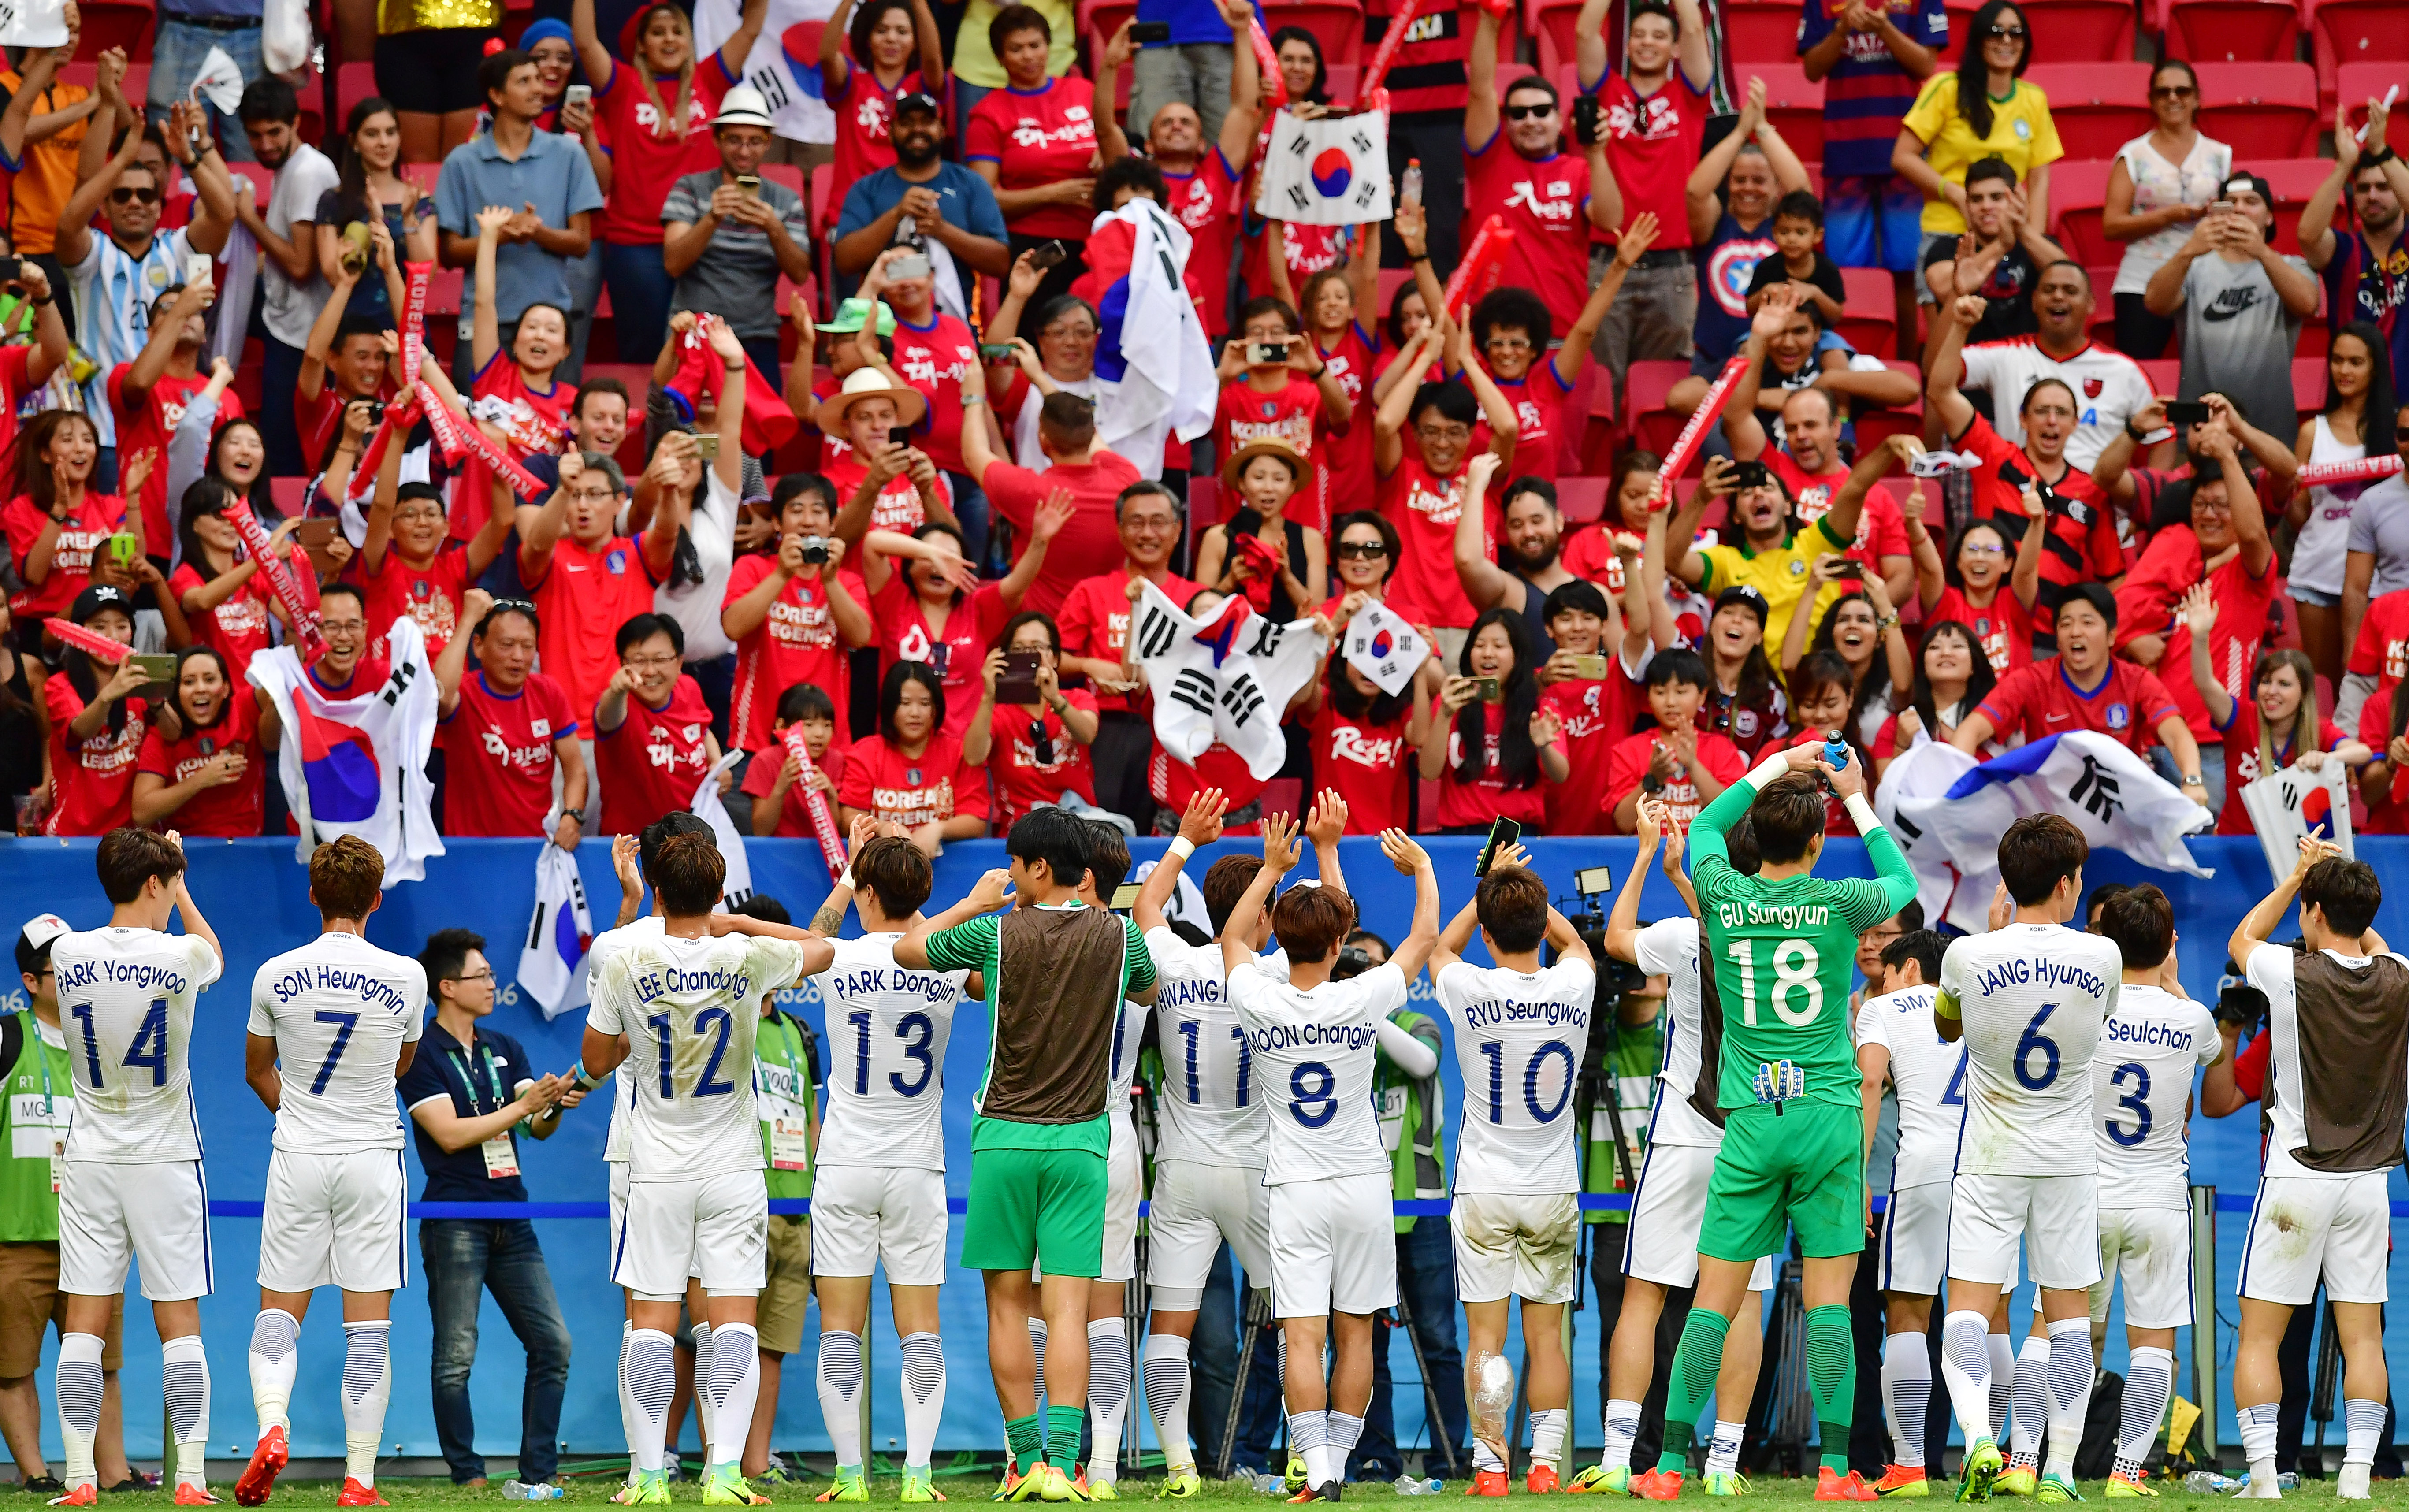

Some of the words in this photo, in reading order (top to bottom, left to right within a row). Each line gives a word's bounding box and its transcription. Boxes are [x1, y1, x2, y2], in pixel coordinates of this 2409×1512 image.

[408, 273, 428, 332] KOREA
[2302, 459, 2366, 478] IGHTING
[238, 513, 279, 575] KOREA
[271, 570, 316, 638] FIGHTING
[873, 788, 937, 809] KOREA
[807, 791, 847, 871] FIGHTING
[1720, 903, 1744, 929] GU
[1748, 902, 1828, 929] Sungyun
[59, 962, 97, 997] PARK
[104, 960, 186, 995] Yongwoo
[274, 968, 313, 1003] SON
[316, 966, 405, 1016] Heungmin
[635, 973, 664, 1004] LEE
[666, 968, 748, 1000] Chandong
[834, 970, 886, 1000] PARK
[893, 969, 955, 1003] Dongjin
[1729, 939, 1823, 1027] 18
[1893, 995, 1928, 1013] SIM
[1978, 959, 2030, 997] JANG
[2035, 958, 2105, 999] Hyunsoo
[72, 999, 167, 1087] 14
[1246, 1026, 1299, 1056] MOON
[1304, 1023, 1376, 1050] Changjin
[1465, 1002, 1501, 1029] RYU
[1506, 999, 1587, 1029] Seungwoo
[2108, 1018, 2192, 1049] Seulchan
[311, 1011, 358, 1095] 7
[649, 1007, 734, 1098] 12
[850, 1012, 934, 1097] 13
[2015, 1003, 2060, 1090] 6
[1289, 1062, 1338, 1128] 8
[1481, 1040, 1575, 1124] 10
[2107, 1062, 2152, 1147] 3
